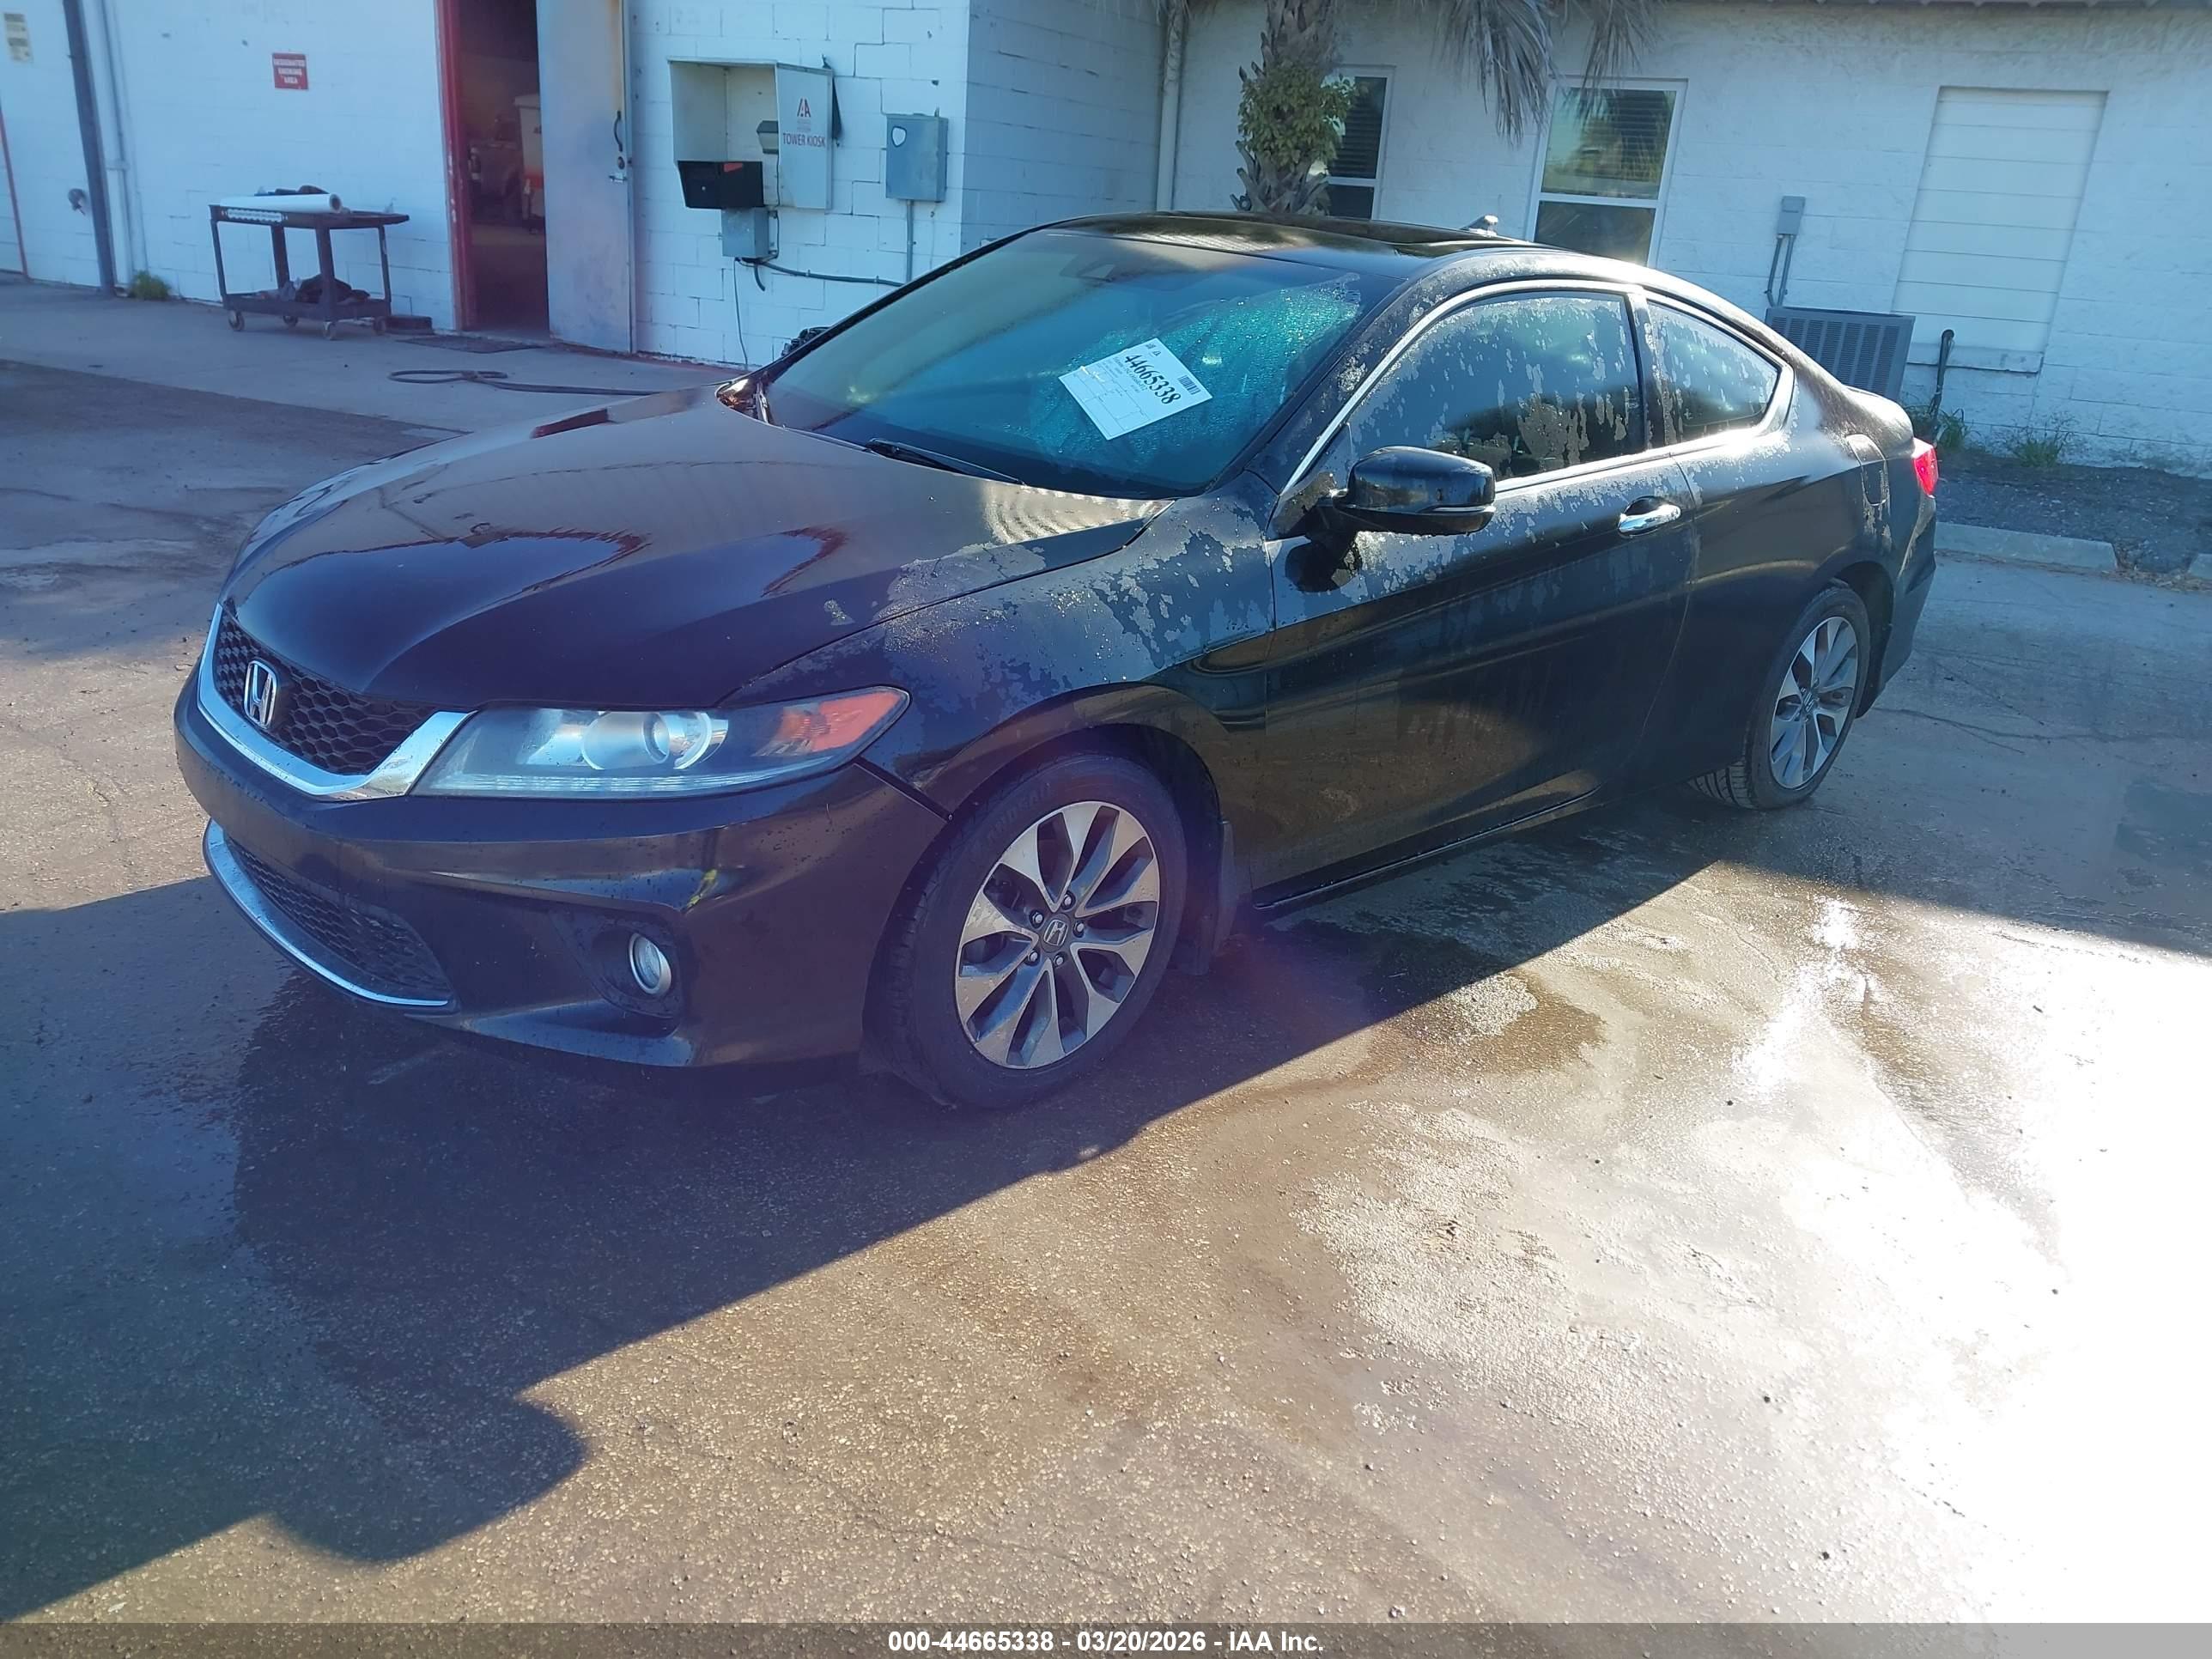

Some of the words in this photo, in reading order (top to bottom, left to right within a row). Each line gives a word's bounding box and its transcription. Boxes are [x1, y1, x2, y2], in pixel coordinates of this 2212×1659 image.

[783, 132, 805, 146] TOWER
[807, 135, 826, 148] KIOSK
[1124, 355, 1182, 404] 44665338
